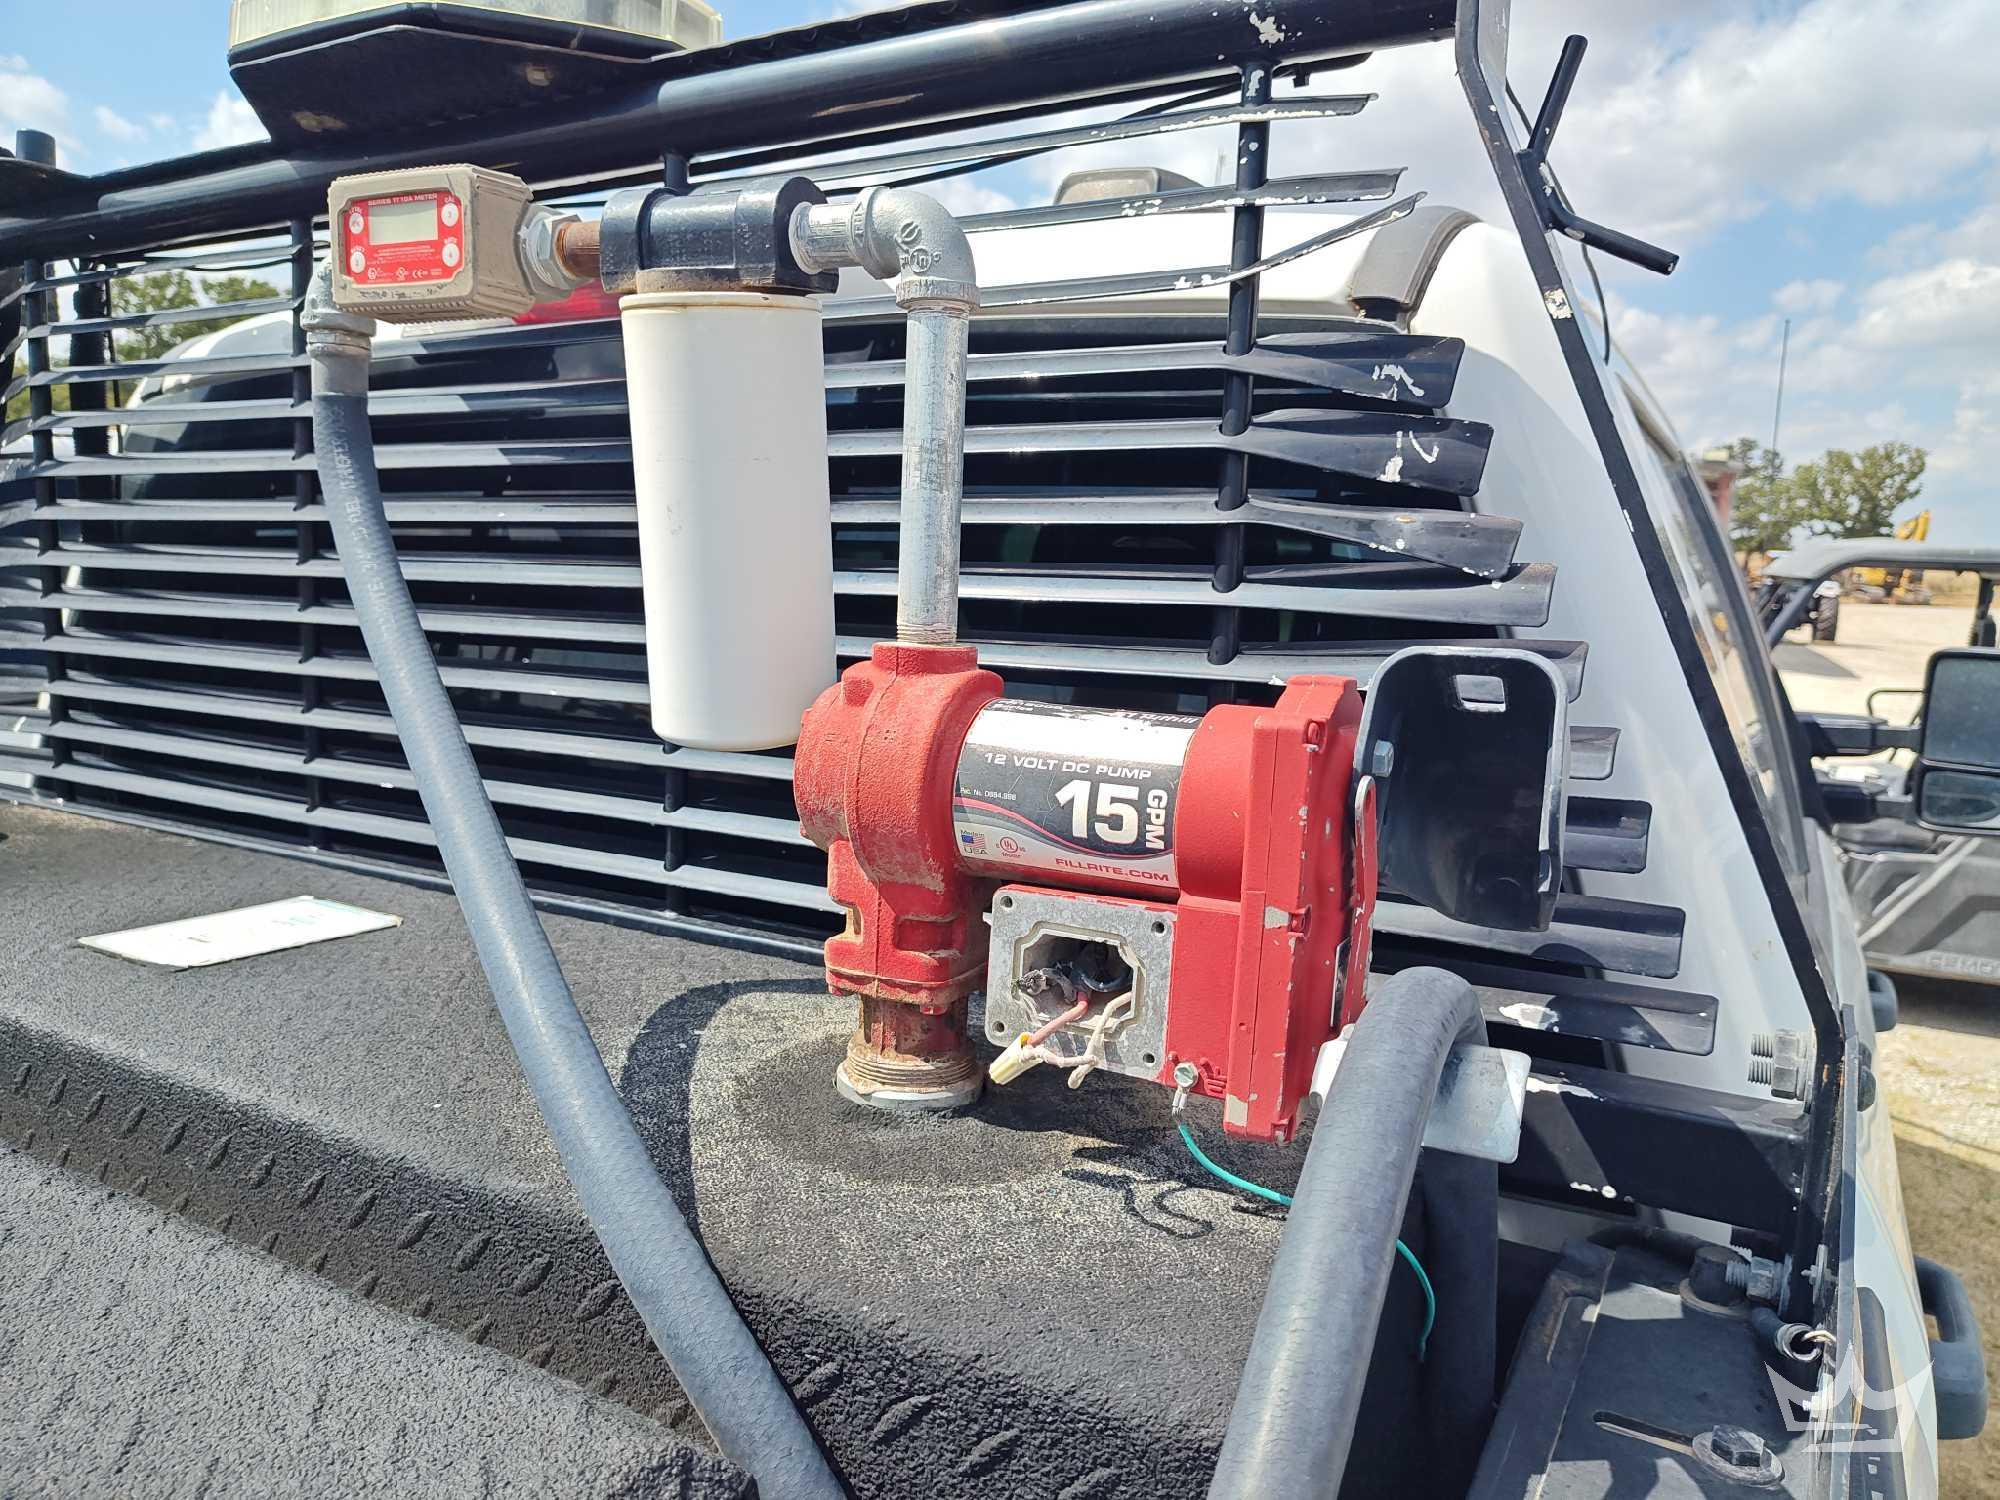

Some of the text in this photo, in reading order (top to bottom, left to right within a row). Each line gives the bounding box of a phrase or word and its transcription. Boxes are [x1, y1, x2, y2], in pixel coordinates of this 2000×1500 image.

[984, 752, 1152, 780] 12 VOLT DC PUMP
[1055, 780, 1140, 845] 15
[1145, 789, 1168, 850] GPM
[964, 847, 989, 855] USA
[1055, 858, 1169, 882] FILLRITE.COM
